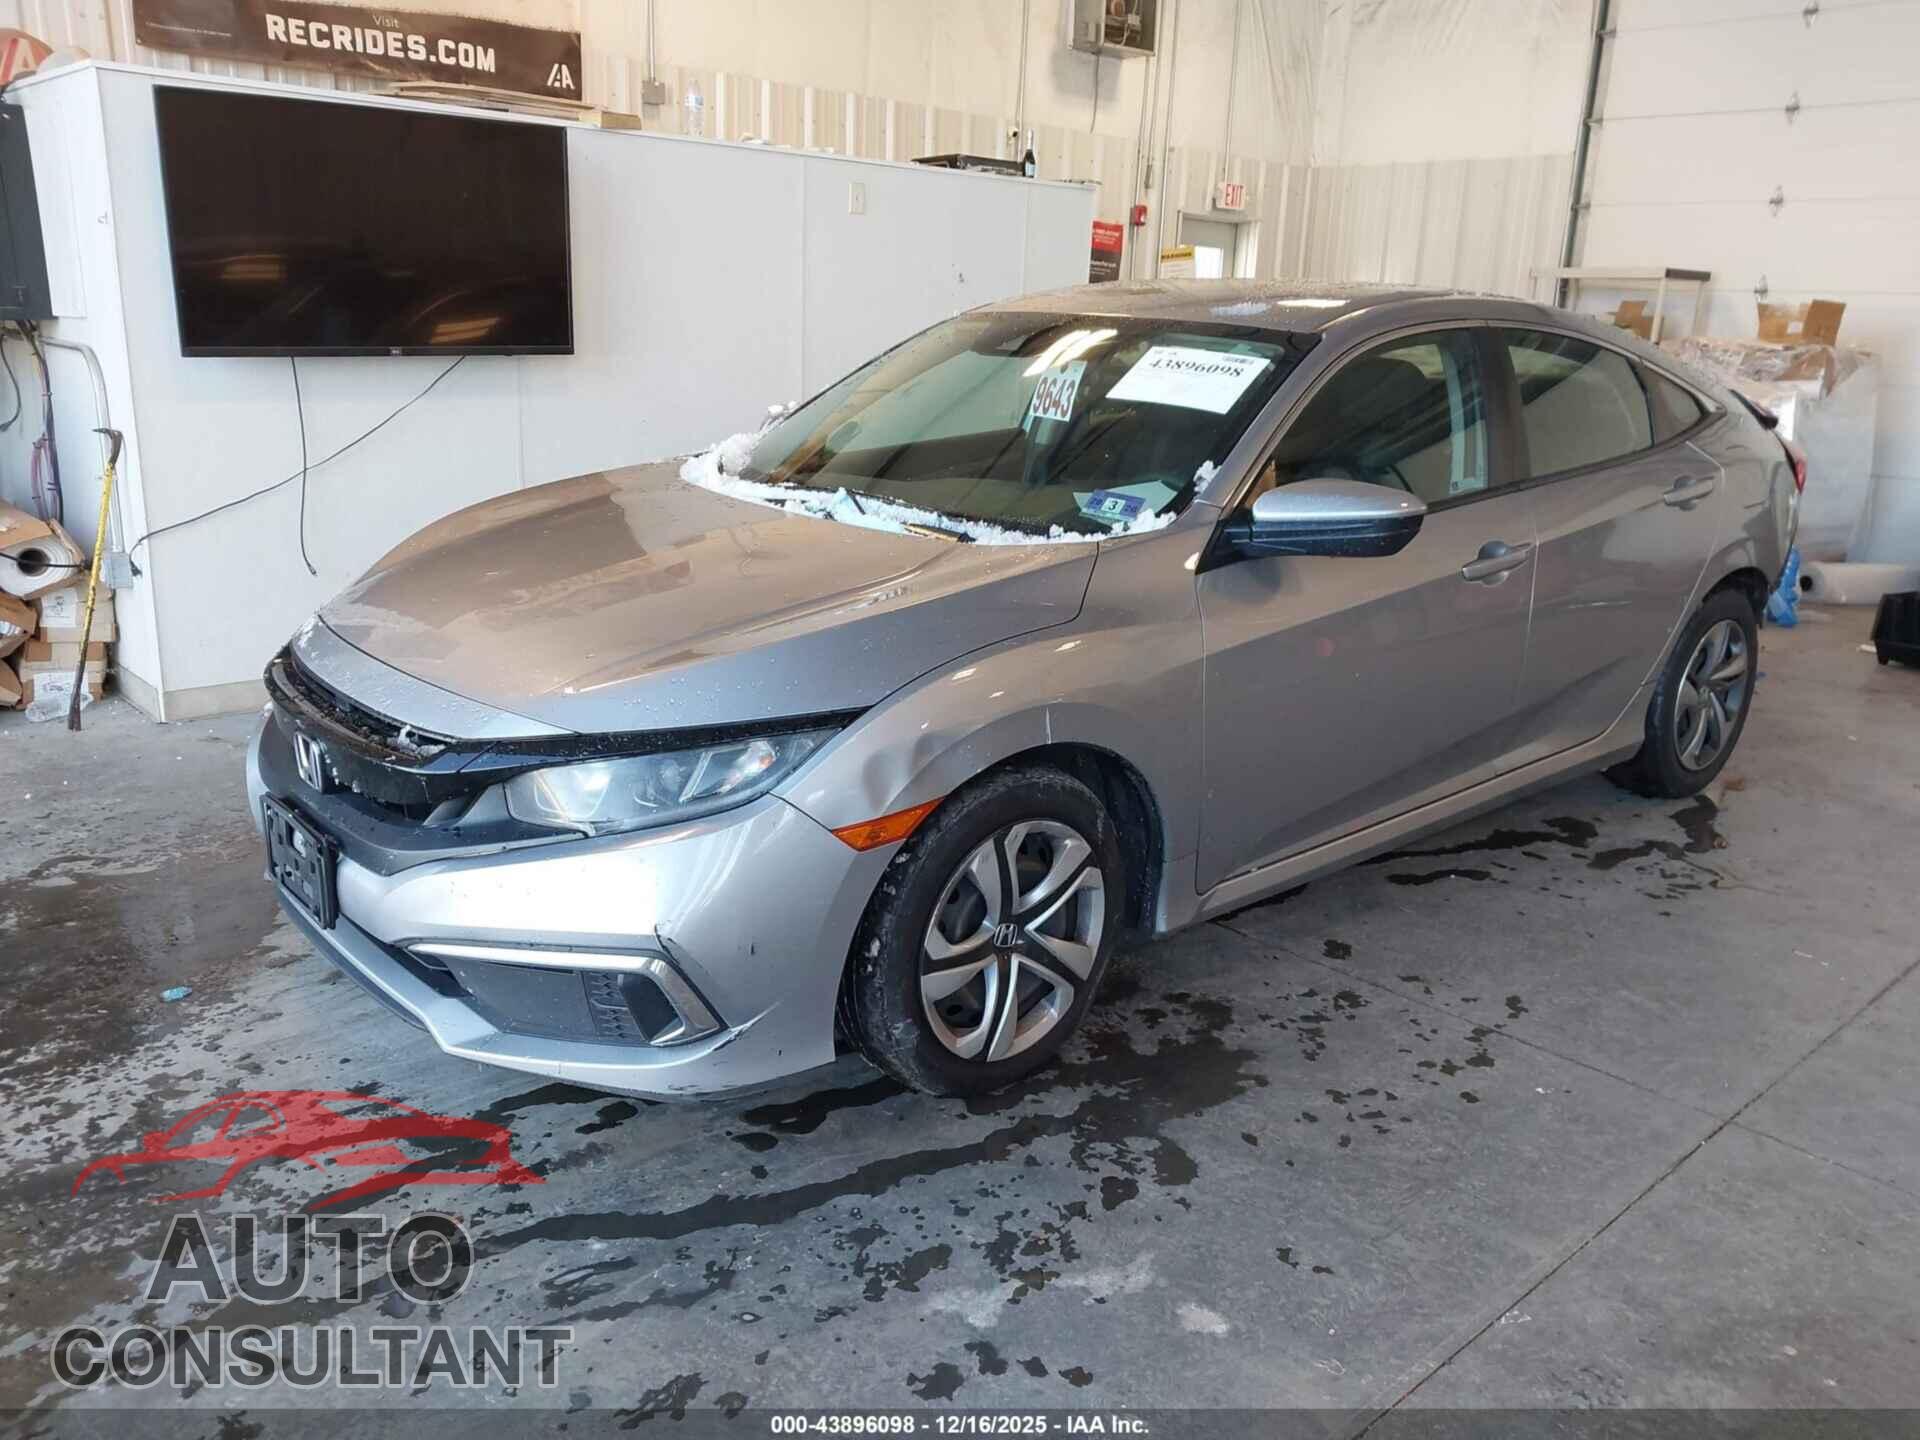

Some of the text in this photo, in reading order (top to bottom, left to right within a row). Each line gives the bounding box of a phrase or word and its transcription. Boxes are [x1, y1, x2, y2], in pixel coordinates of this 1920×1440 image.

[371, 14, 400, 29] Visit
[265, 13, 496, 73] RECRIDES.COM
[1225, 183, 1244, 208] EXIT
[1149, 358, 1245, 378] 43896098
[1032, 376, 1076, 419] 9643
[1108, 500, 1119, 511] 3
